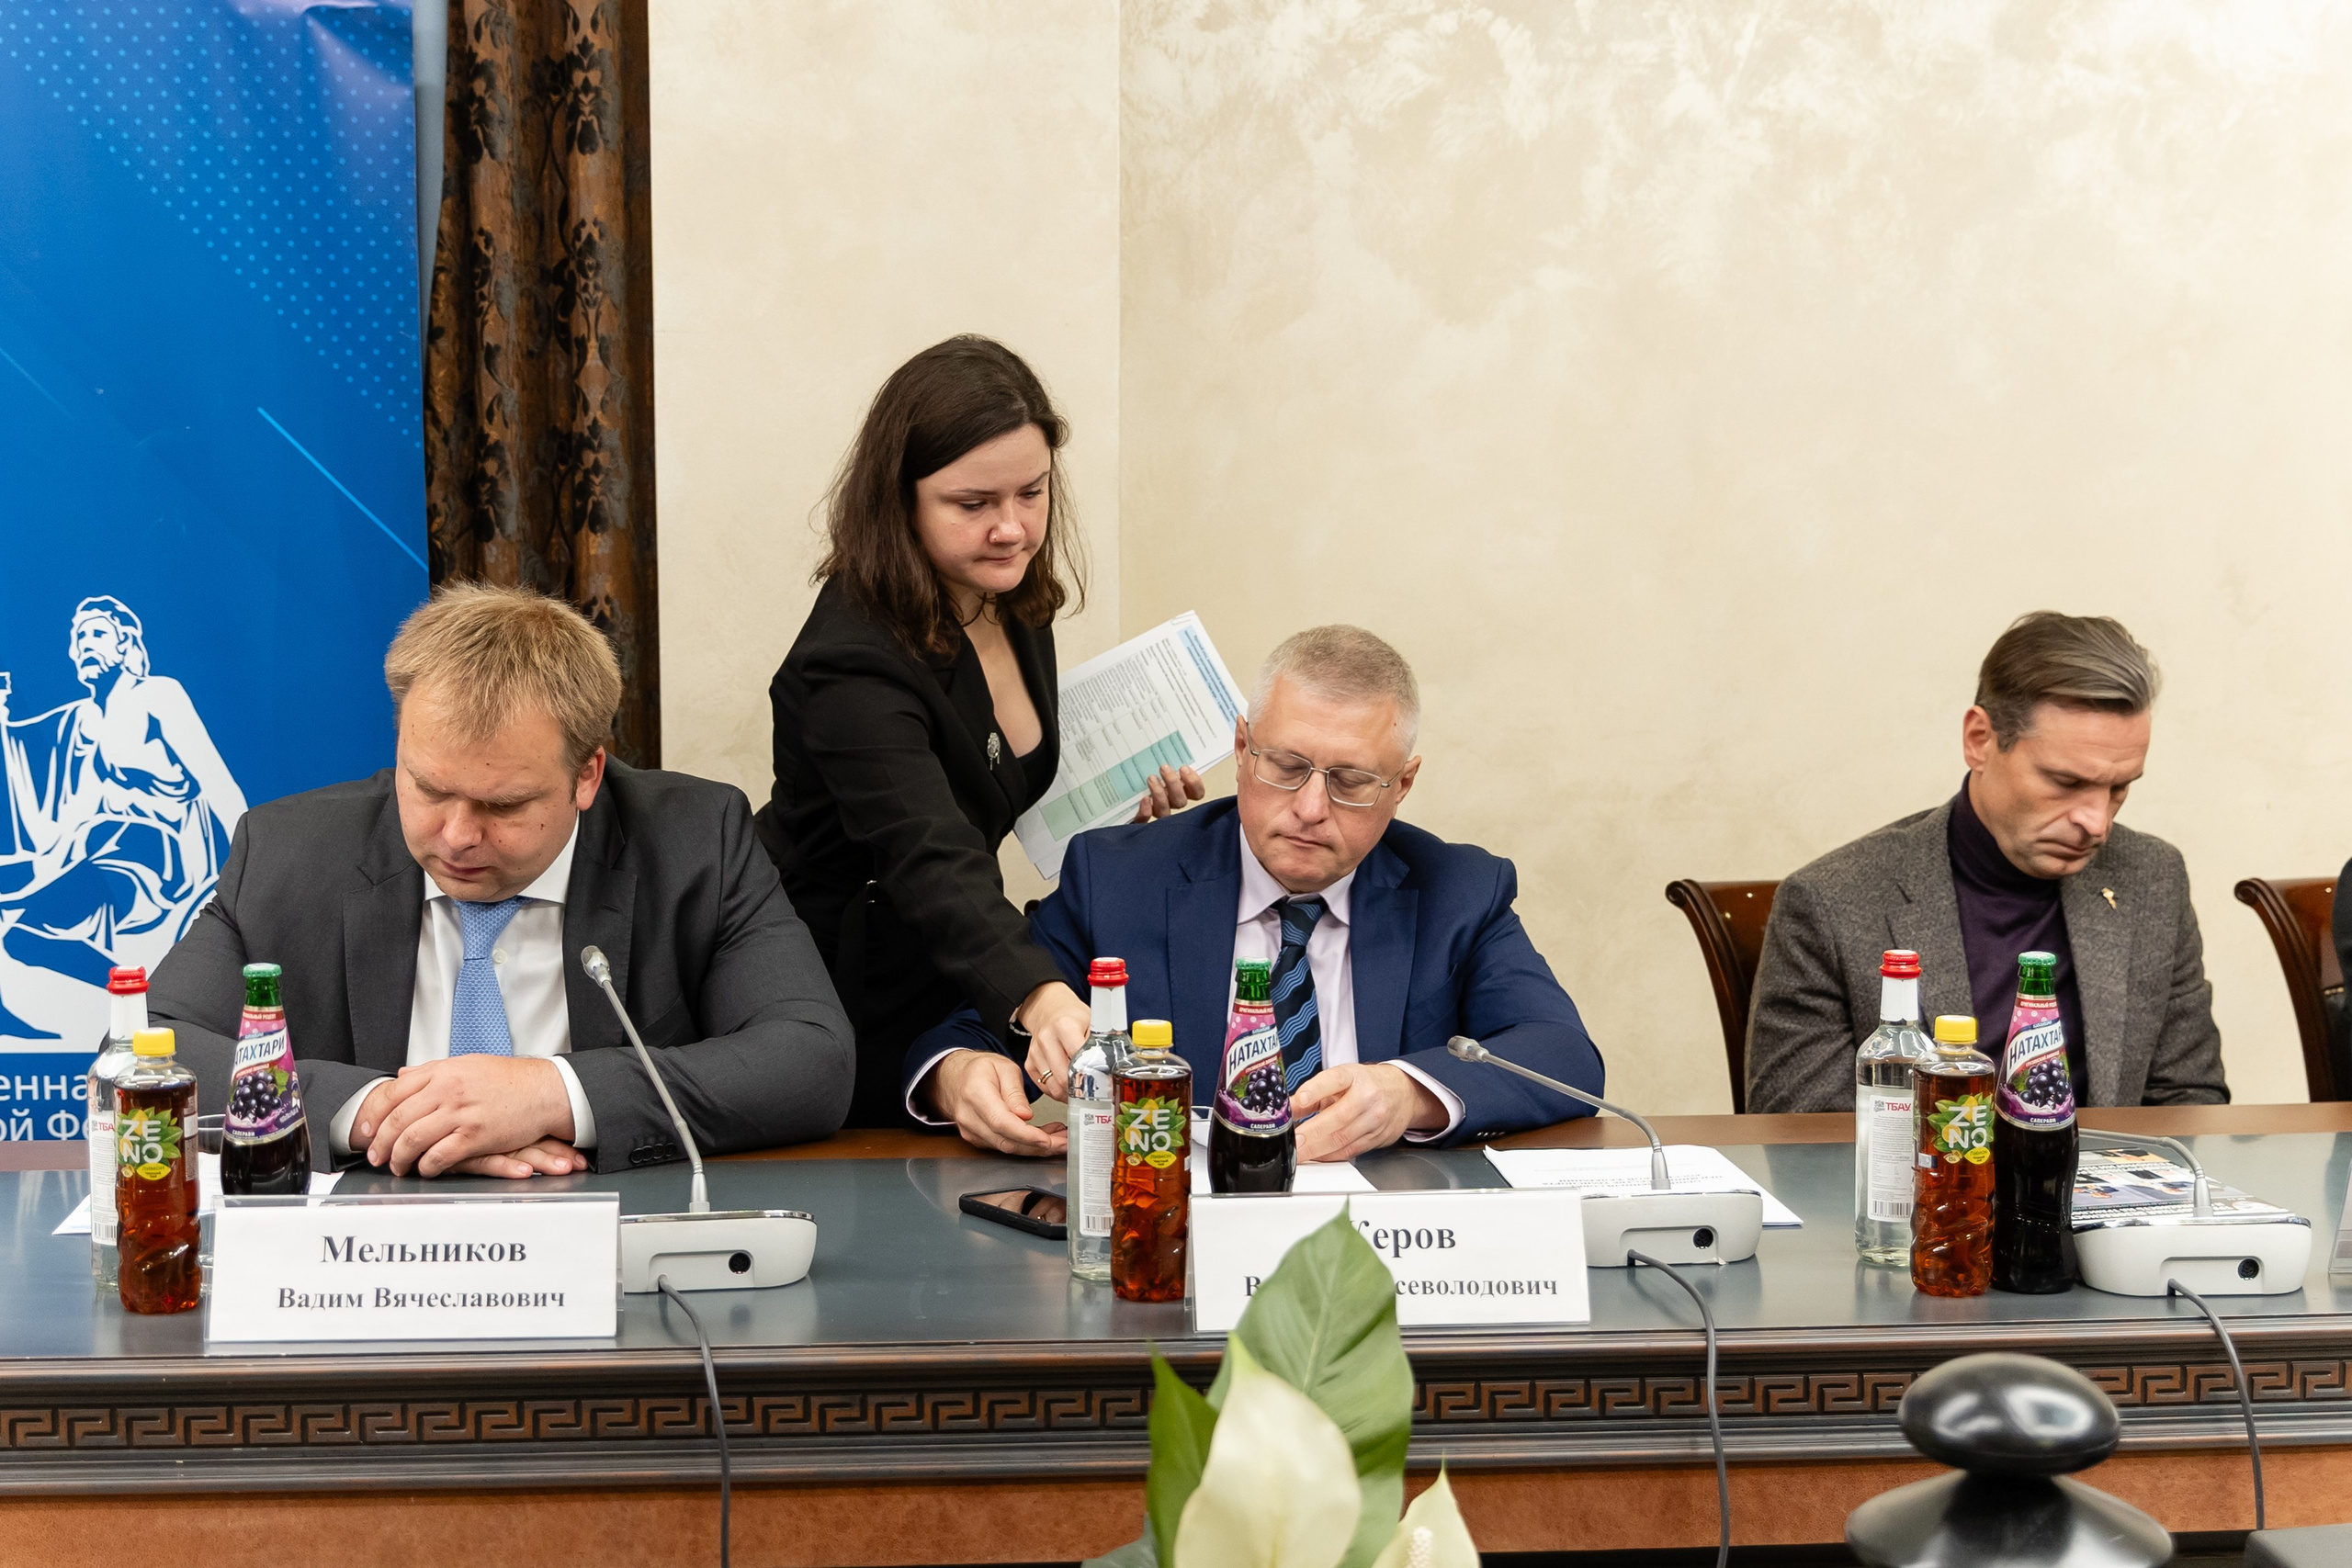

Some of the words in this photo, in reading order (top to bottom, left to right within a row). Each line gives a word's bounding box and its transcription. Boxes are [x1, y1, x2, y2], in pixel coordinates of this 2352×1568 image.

[1129, 1108, 1170, 1130] ZE
[1948, 1105, 1987, 1127] ZE
[122, 1119, 162, 1142] ZE
[1129, 1130, 1171, 1152] NO
[1948, 1127, 1987, 1148] NO
[122, 1142, 164, 1164] NO
[320, 1235, 527, 1263] Мельников
[277, 1287, 365, 1311] Вадим
[372, 1287, 566, 1308] Вячеславович
[1395, 1278, 1558, 1298] севолодович
